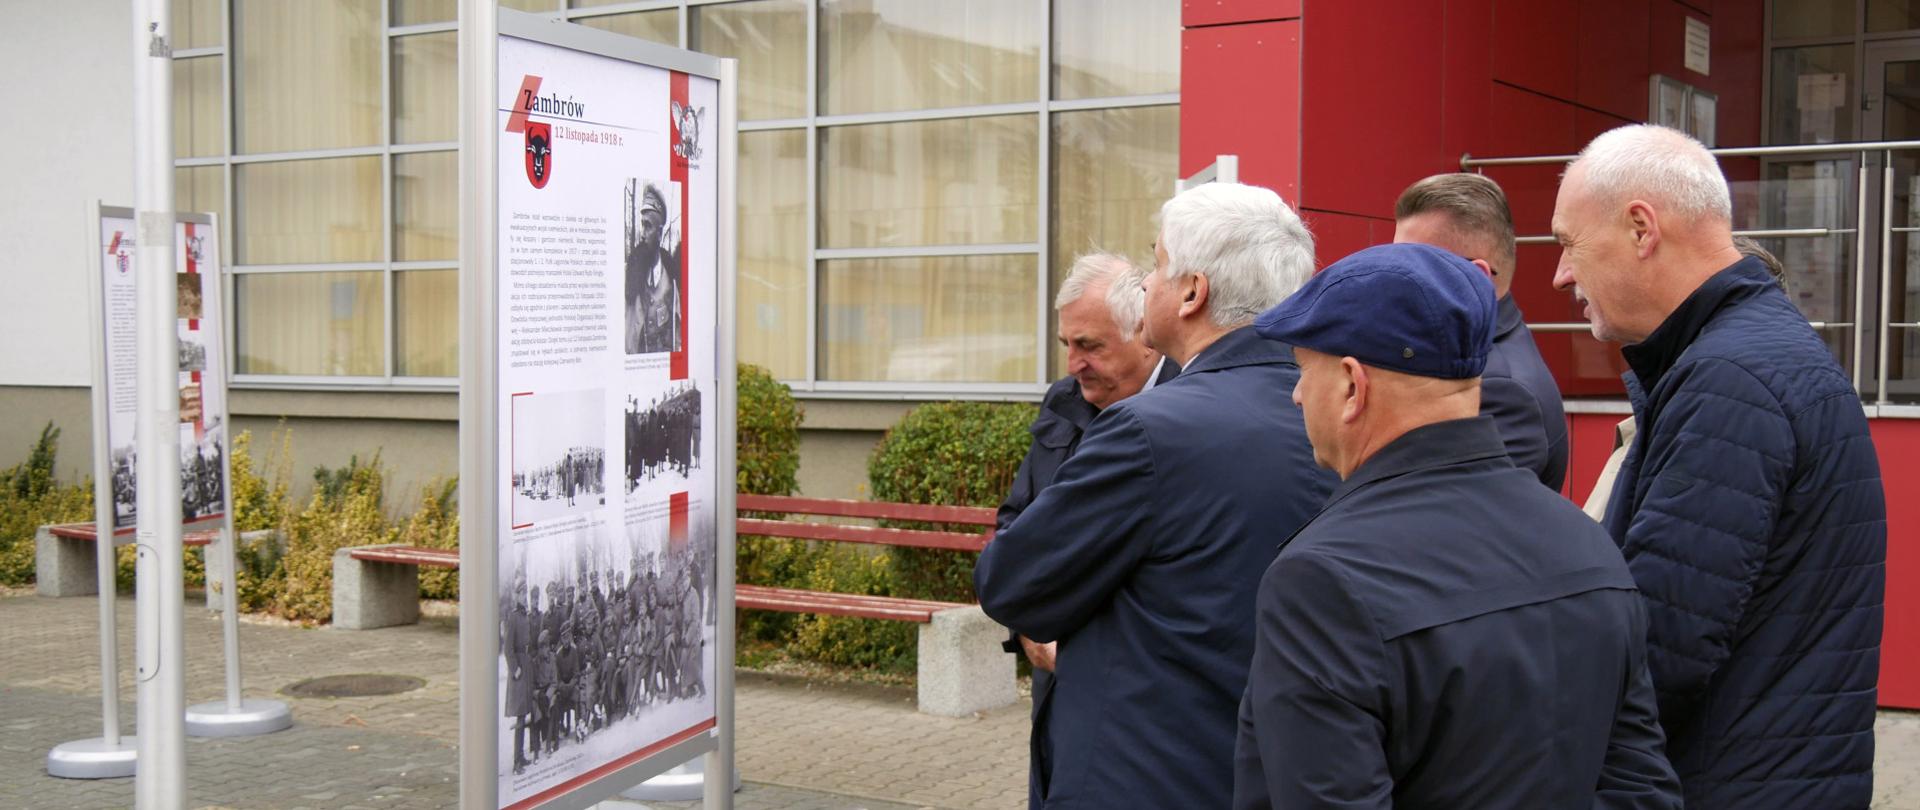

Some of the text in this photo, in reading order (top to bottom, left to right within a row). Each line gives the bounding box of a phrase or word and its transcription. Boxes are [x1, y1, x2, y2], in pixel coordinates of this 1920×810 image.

[524, 89, 585, 118] Zambrów
[555, 126, 564, 139] 12
[565, 127, 599, 144] listopada
[600, 133, 617, 147] 1918
